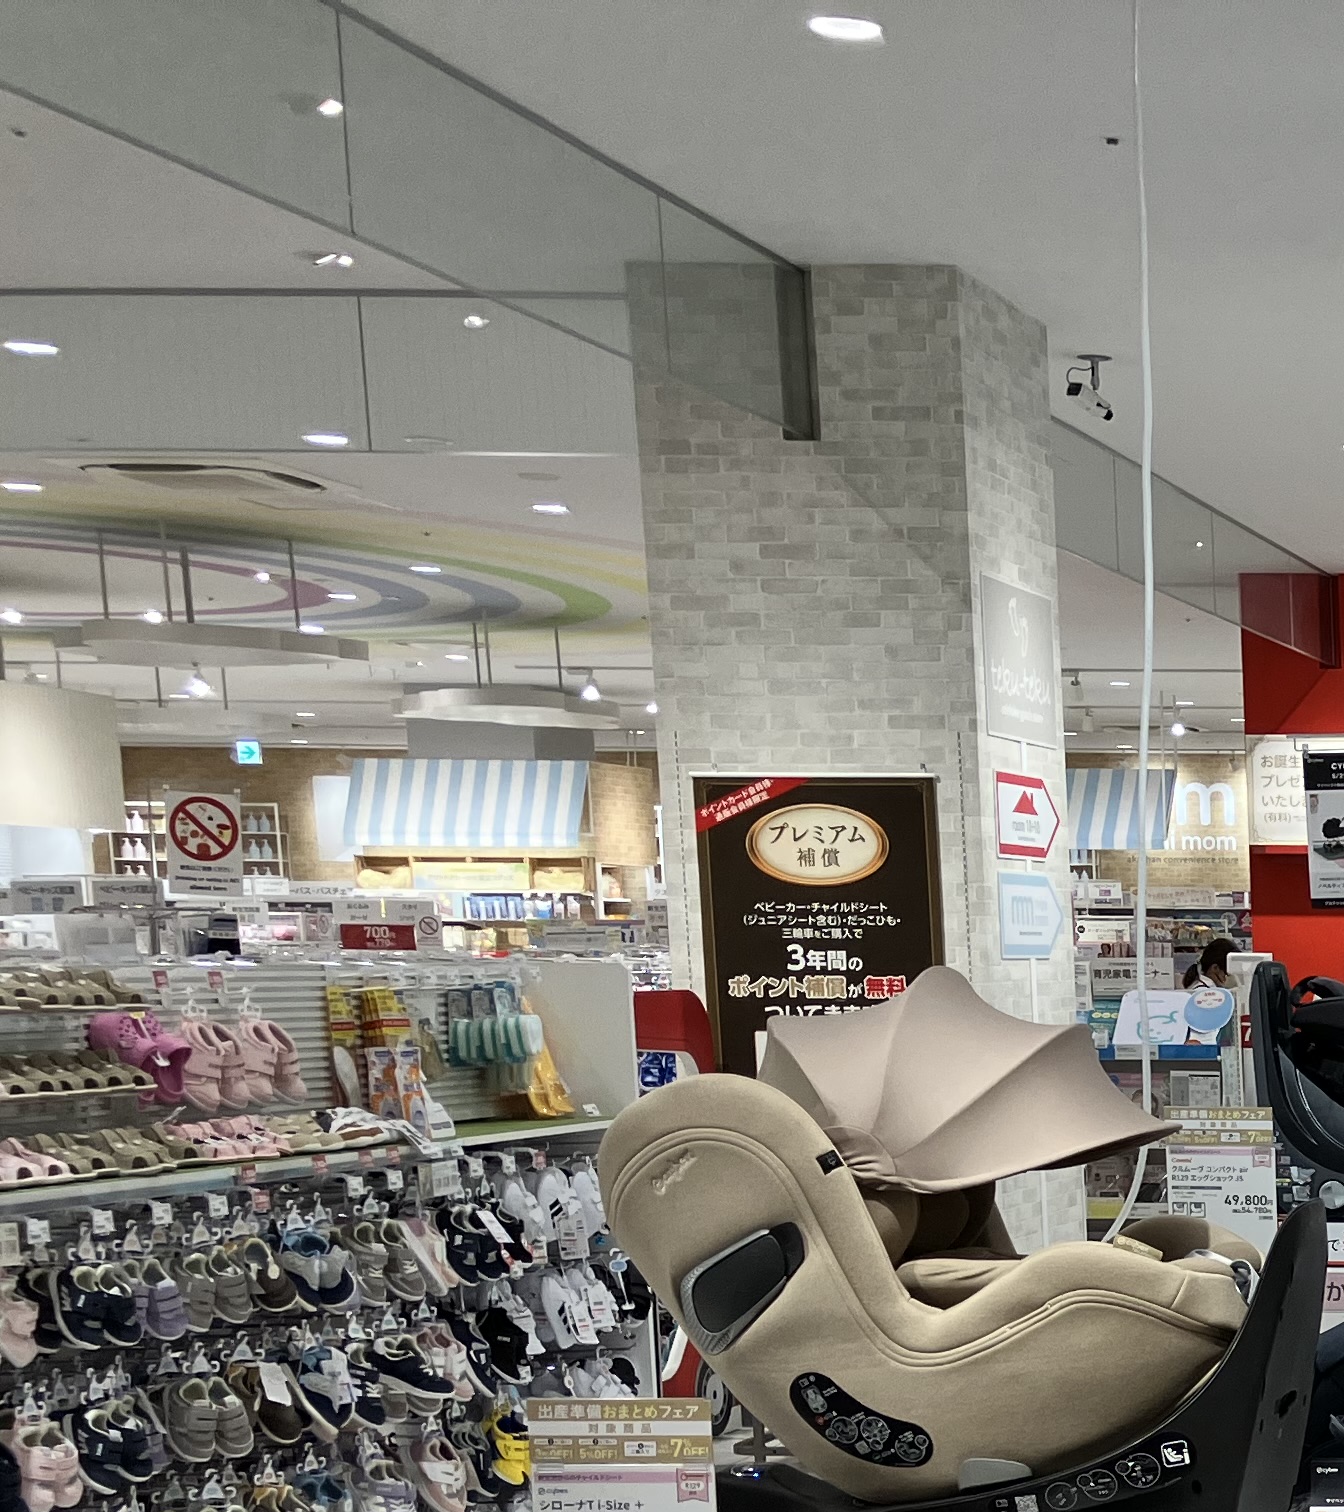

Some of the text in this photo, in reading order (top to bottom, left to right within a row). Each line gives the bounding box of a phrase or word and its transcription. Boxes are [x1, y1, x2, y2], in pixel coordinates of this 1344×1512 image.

[769, 822, 866, 845] プレミアム
[1182, 832, 1237, 852] mom
[796, 847, 841, 868] 補償
[754, 902, 887, 913] ベビーカー・チャイルドシート
[786, 943, 863, 972] 3年間の
[1170, 1110, 1265, 1119] 出産準備おまとめフェア
[1225, 1195, 1273, 1206] 49,800円
[538, 1404, 699, 1419] 出産準備おまとめフェア
[539, 1500, 594, 1511] シローナT
